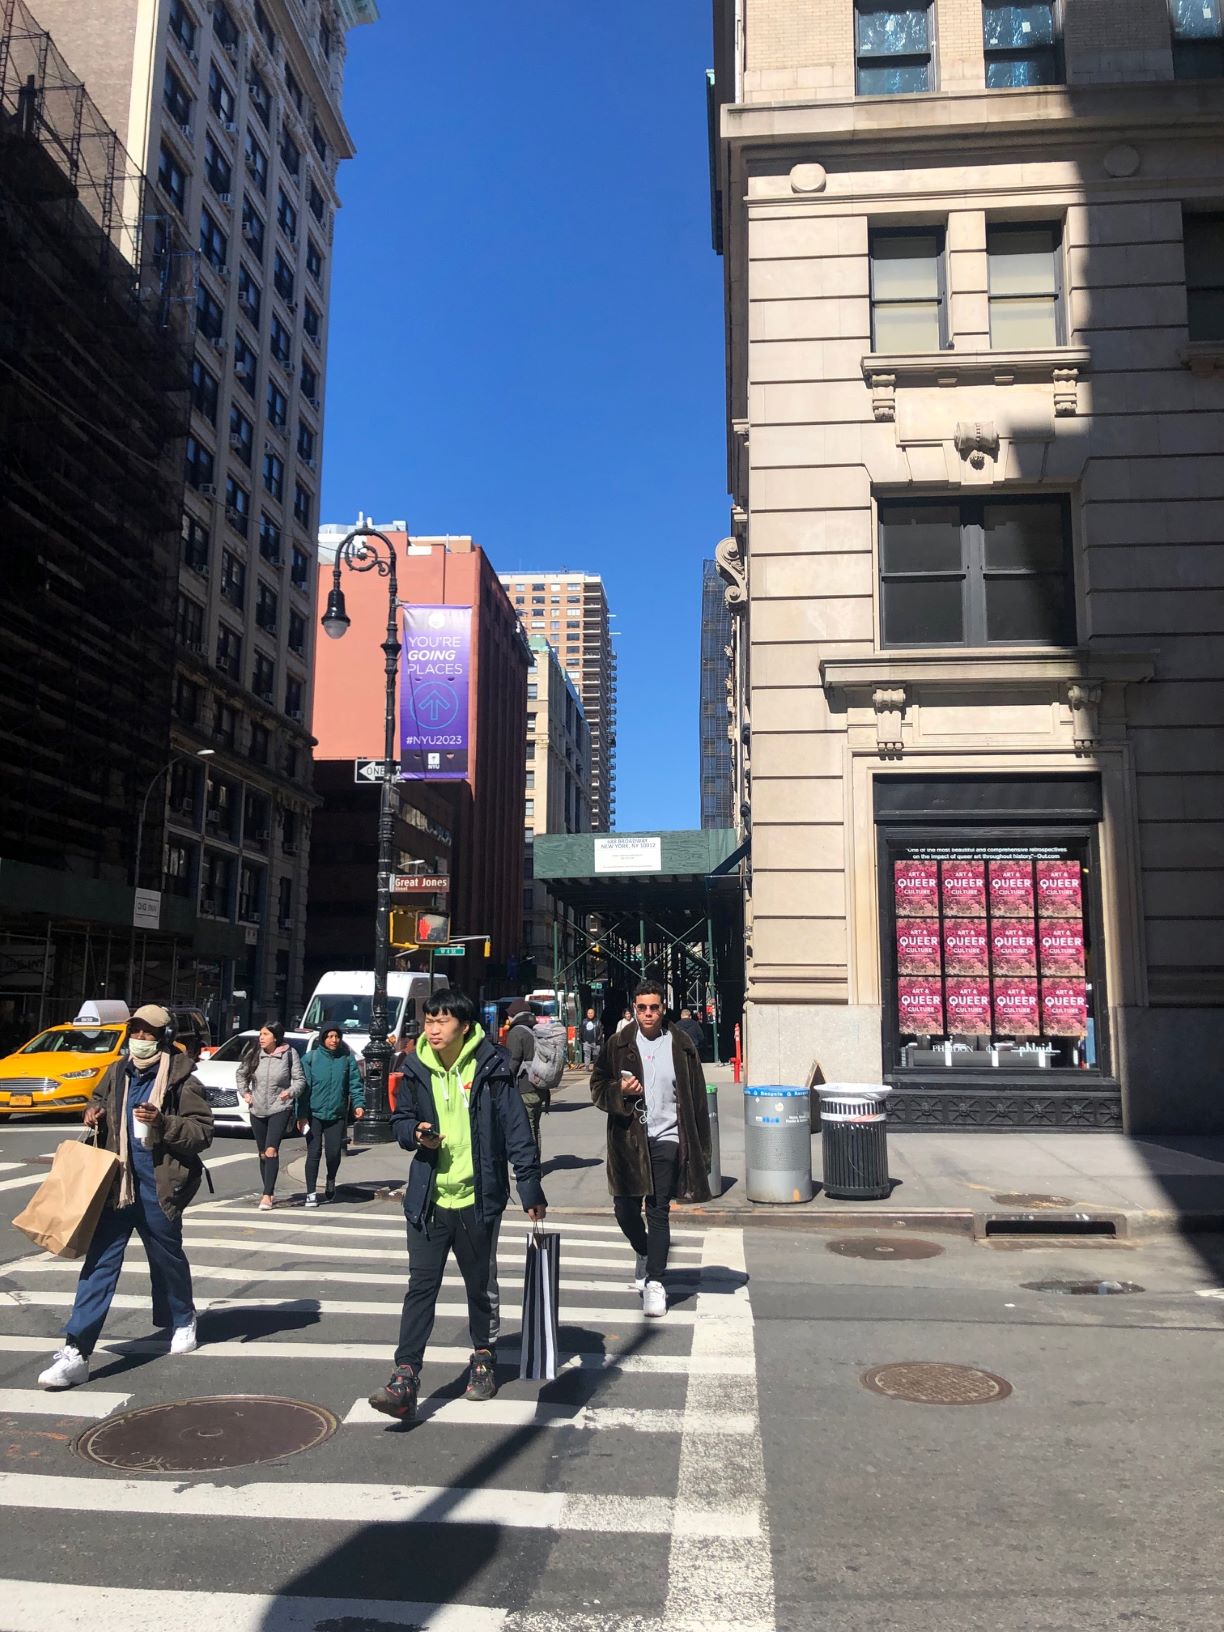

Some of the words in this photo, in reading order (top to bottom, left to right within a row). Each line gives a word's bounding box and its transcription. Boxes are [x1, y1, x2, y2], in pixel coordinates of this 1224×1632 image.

[408, 636, 462, 647] YOU'RE
[408, 650, 456, 661] GOING
[408, 663, 463, 675] PLACES
[406, 735, 462, 745] #NYU2023
[366, 767, 385, 776] ONE
[395, 878, 418, 887] Great
[421, 878, 447, 887] Jones
[897, 878, 936, 889] QUEER
[944, 878, 983, 889] QUEER
[992, 878, 1031, 889] QUEER
[1040, 878, 1079, 889] QUEER
[899, 936, 938, 947] QUEER
[946, 936, 985, 947] QUEER
[994, 937, 1033, 948] QUEER
[1042, 937, 1081, 948] QUEER
[901, 995, 940, 1006] QUEER
[949, 996, 988, 1007] QUEER
[997, 996, 1036, 1007] QUEER
[1045, 996, 1084, 1007] QUEER
